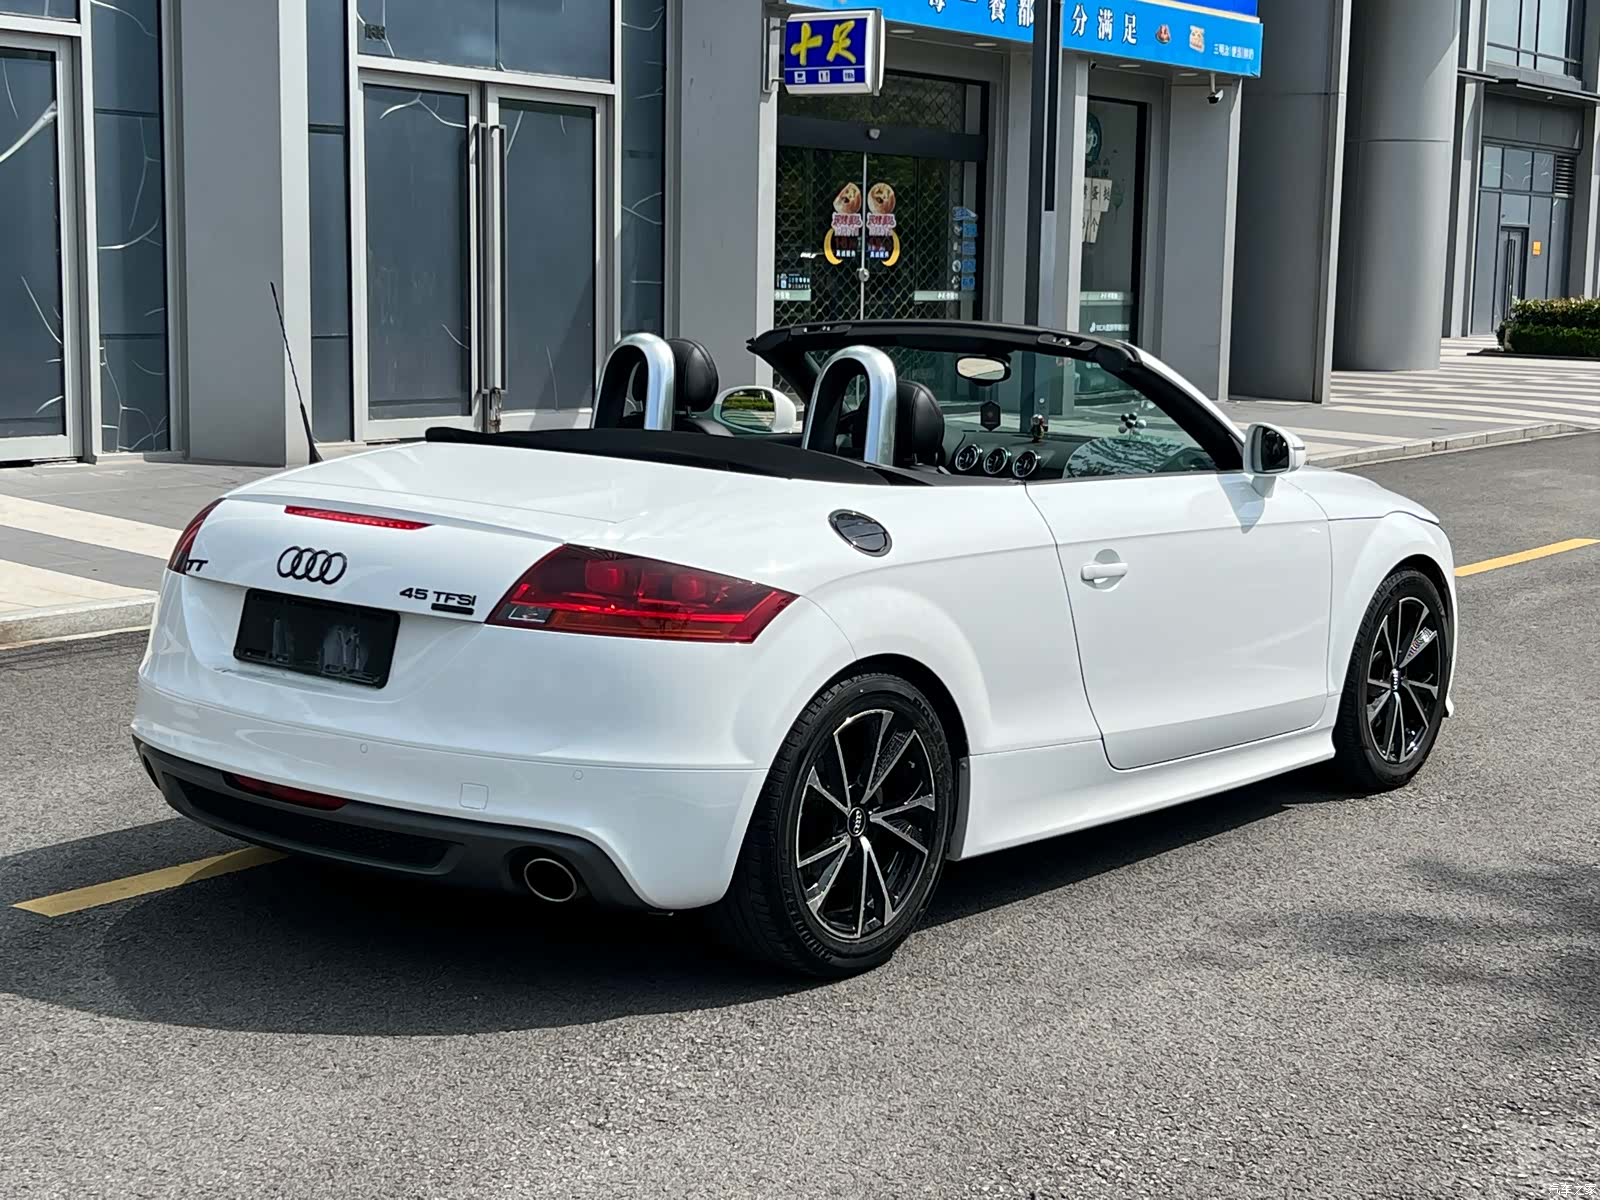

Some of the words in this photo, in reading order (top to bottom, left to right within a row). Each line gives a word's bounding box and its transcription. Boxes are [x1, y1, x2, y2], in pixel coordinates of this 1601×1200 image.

[790, 20, 857, 66] 十足
[186, 559, 209, 572] TT
[399, 587, 429, 600] 45
[432, 591, 477, 606] TFSI
